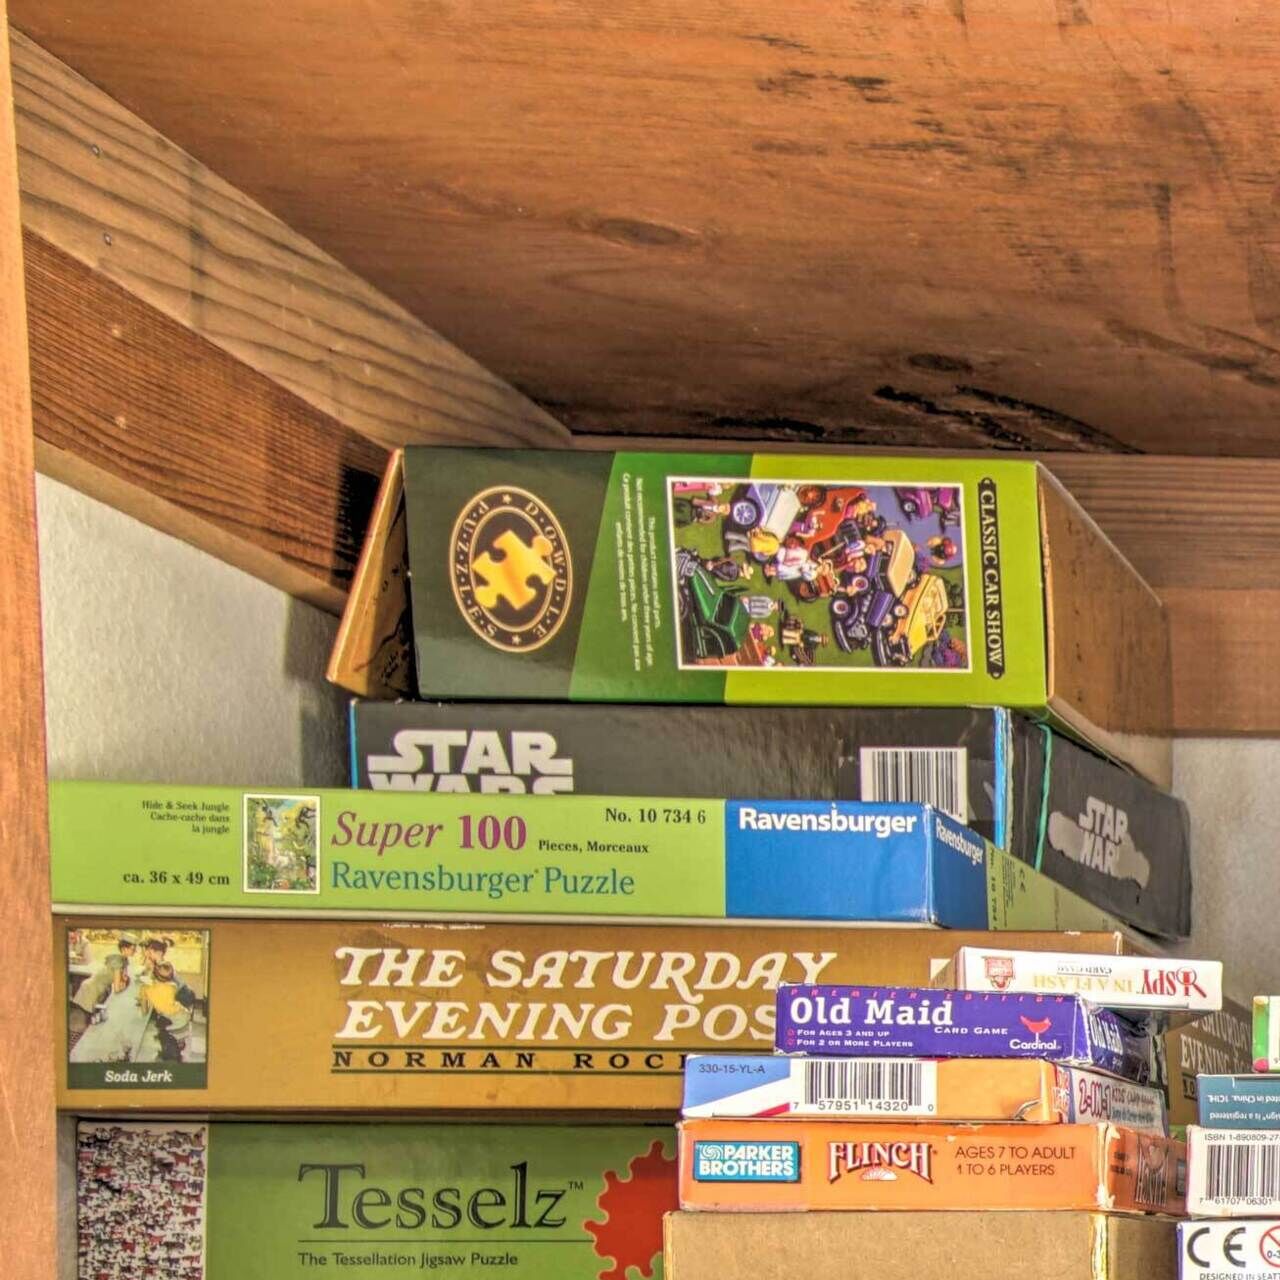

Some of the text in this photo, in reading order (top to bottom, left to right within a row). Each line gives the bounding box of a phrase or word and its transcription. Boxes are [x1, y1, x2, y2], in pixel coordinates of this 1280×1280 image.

[980, 491, 1002, 666] CLASSIC CAR SHOW
[367, 730, 573, 774] STAR
[331, 812, 650, 854] Super 100 Pieces, Morceaux
[738, 808, 917, 839] Ravensburger
[331, 863, 635, 900] Ravensburger Puzzle
[337, 947, 837, 991] THE SATURDAY
[336, 1001, 634, 1041] EVENING
[790, 997, 953, 1026] Old Maid
[332, 1051, 535, 1069] NORMAN
[1010, 1040, 1058, 1050] Cardinal
[105, 1070, 172, 1083] Soda Jerk
[699, 1064, 765, 1074] 330-15-YL-A
[722, 1145, 794, 1160] PARKER
[827, 1141, 938, 1185] FLINCH
[699, 1161, 794, 1176] BROTHERS
[298, 1252, 518, 1269] The Tessellation Jigsaw Puzzle
